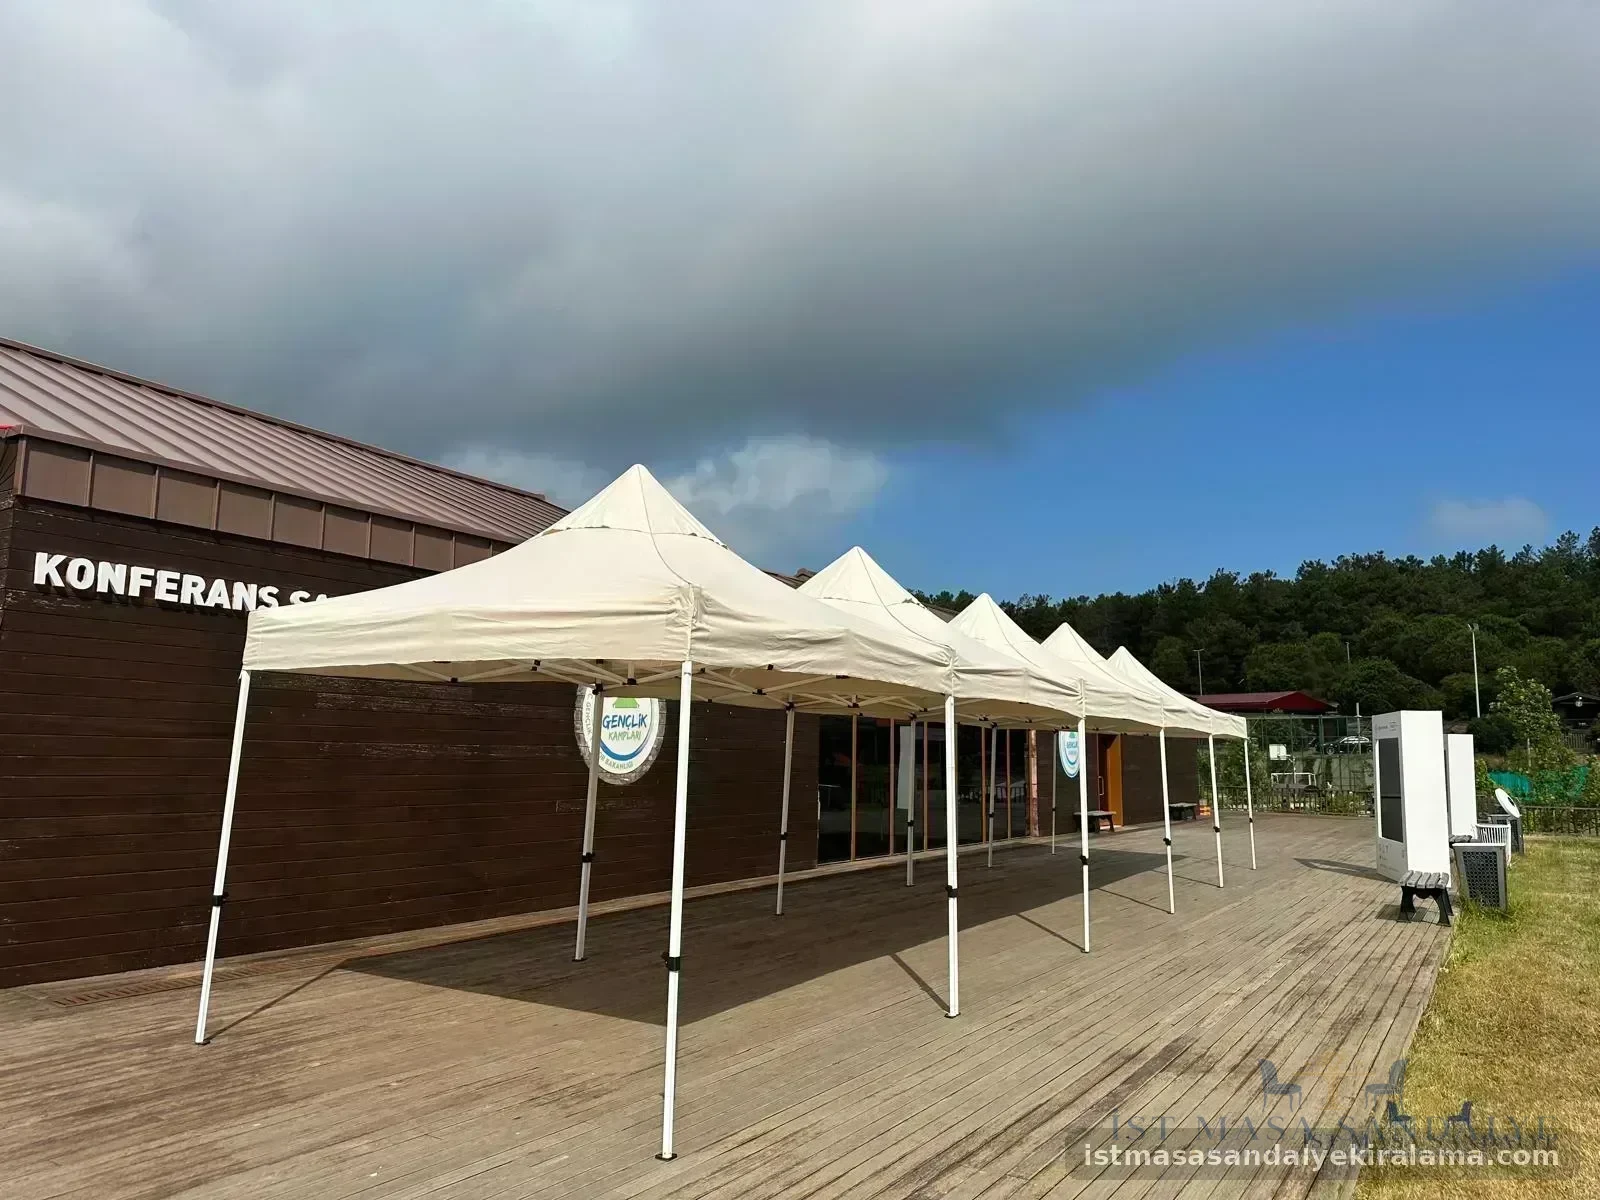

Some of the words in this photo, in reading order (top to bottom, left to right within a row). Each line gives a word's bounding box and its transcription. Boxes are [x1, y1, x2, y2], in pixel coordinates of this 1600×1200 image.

[33, 551, 280, 611] KONFERANS
[602, 713, 648, 730] GENÇLİK
[608, 731, 642, 741] KAMPLARI
